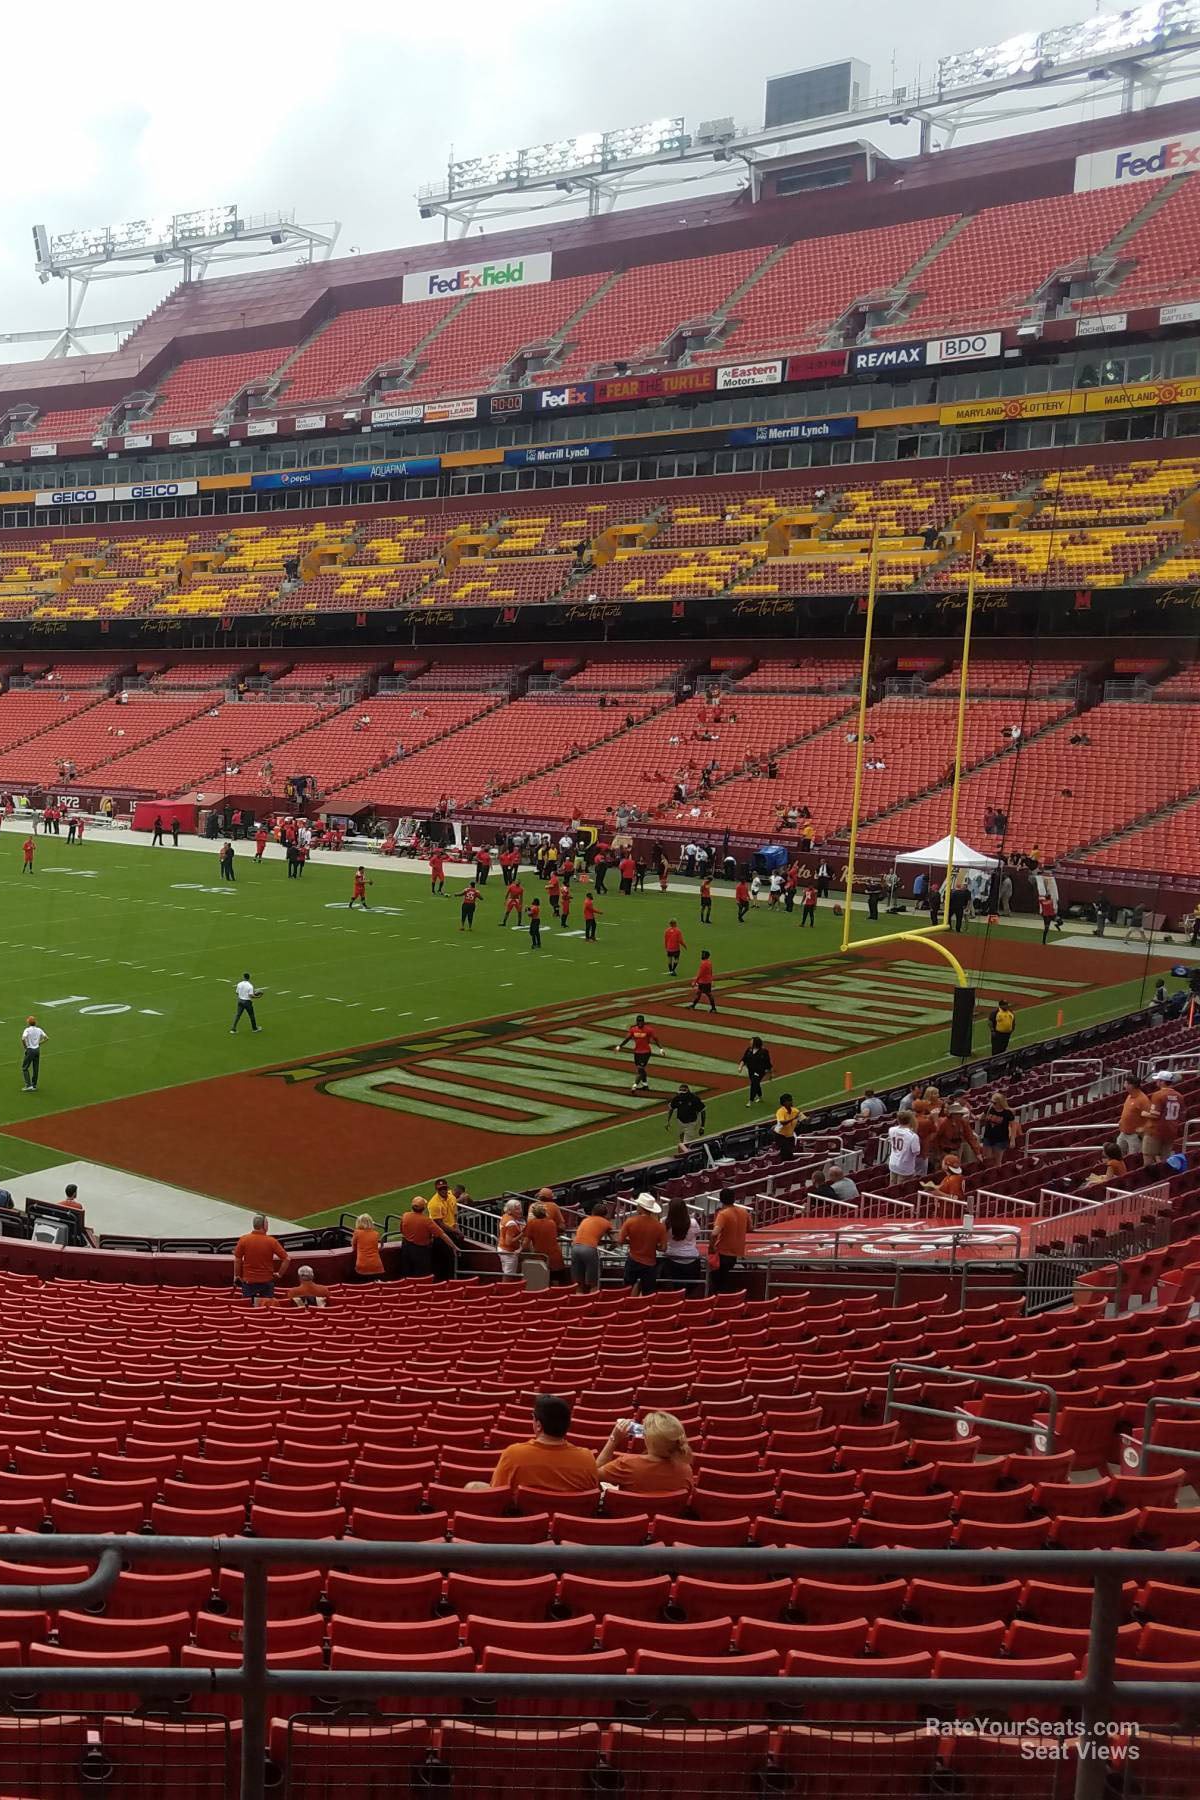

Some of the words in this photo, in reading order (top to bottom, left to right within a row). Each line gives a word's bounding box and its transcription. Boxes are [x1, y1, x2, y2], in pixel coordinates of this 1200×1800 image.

[1115, 142, 1200, 179] FedEx
[429, 261, 524, 295] FedExField
[945, 337, 987, 355] BDO
[857, 348, 920, 369] RE/MAX
[731, 366, 777, 379] Eastern
[542, 388, 586, 408] FedEx
[1105, 391, 1155, 405] MARYLAND
[956, 406, 1003, 418] MARYLAND
[1024, 401, 1064, 413] LOTTERY
[768, 426, 799, 440] Merrill
[802, 423, 829, 438] Lynch
[537, 449, 564, 461] Merrill
[565, 447, 590, 460] Lynch
[290, 473, 311, 485] pepsi
[370, 463, 408, 479] AQUAFINA
[52, 490, 96, 504] GEICO
[132, 484, 179, 498] GEICO
[56, 795, 80, 809] 1972
[34, 995, 131, 1015] 10
[1164, 1101, 1180, 1121] 10
